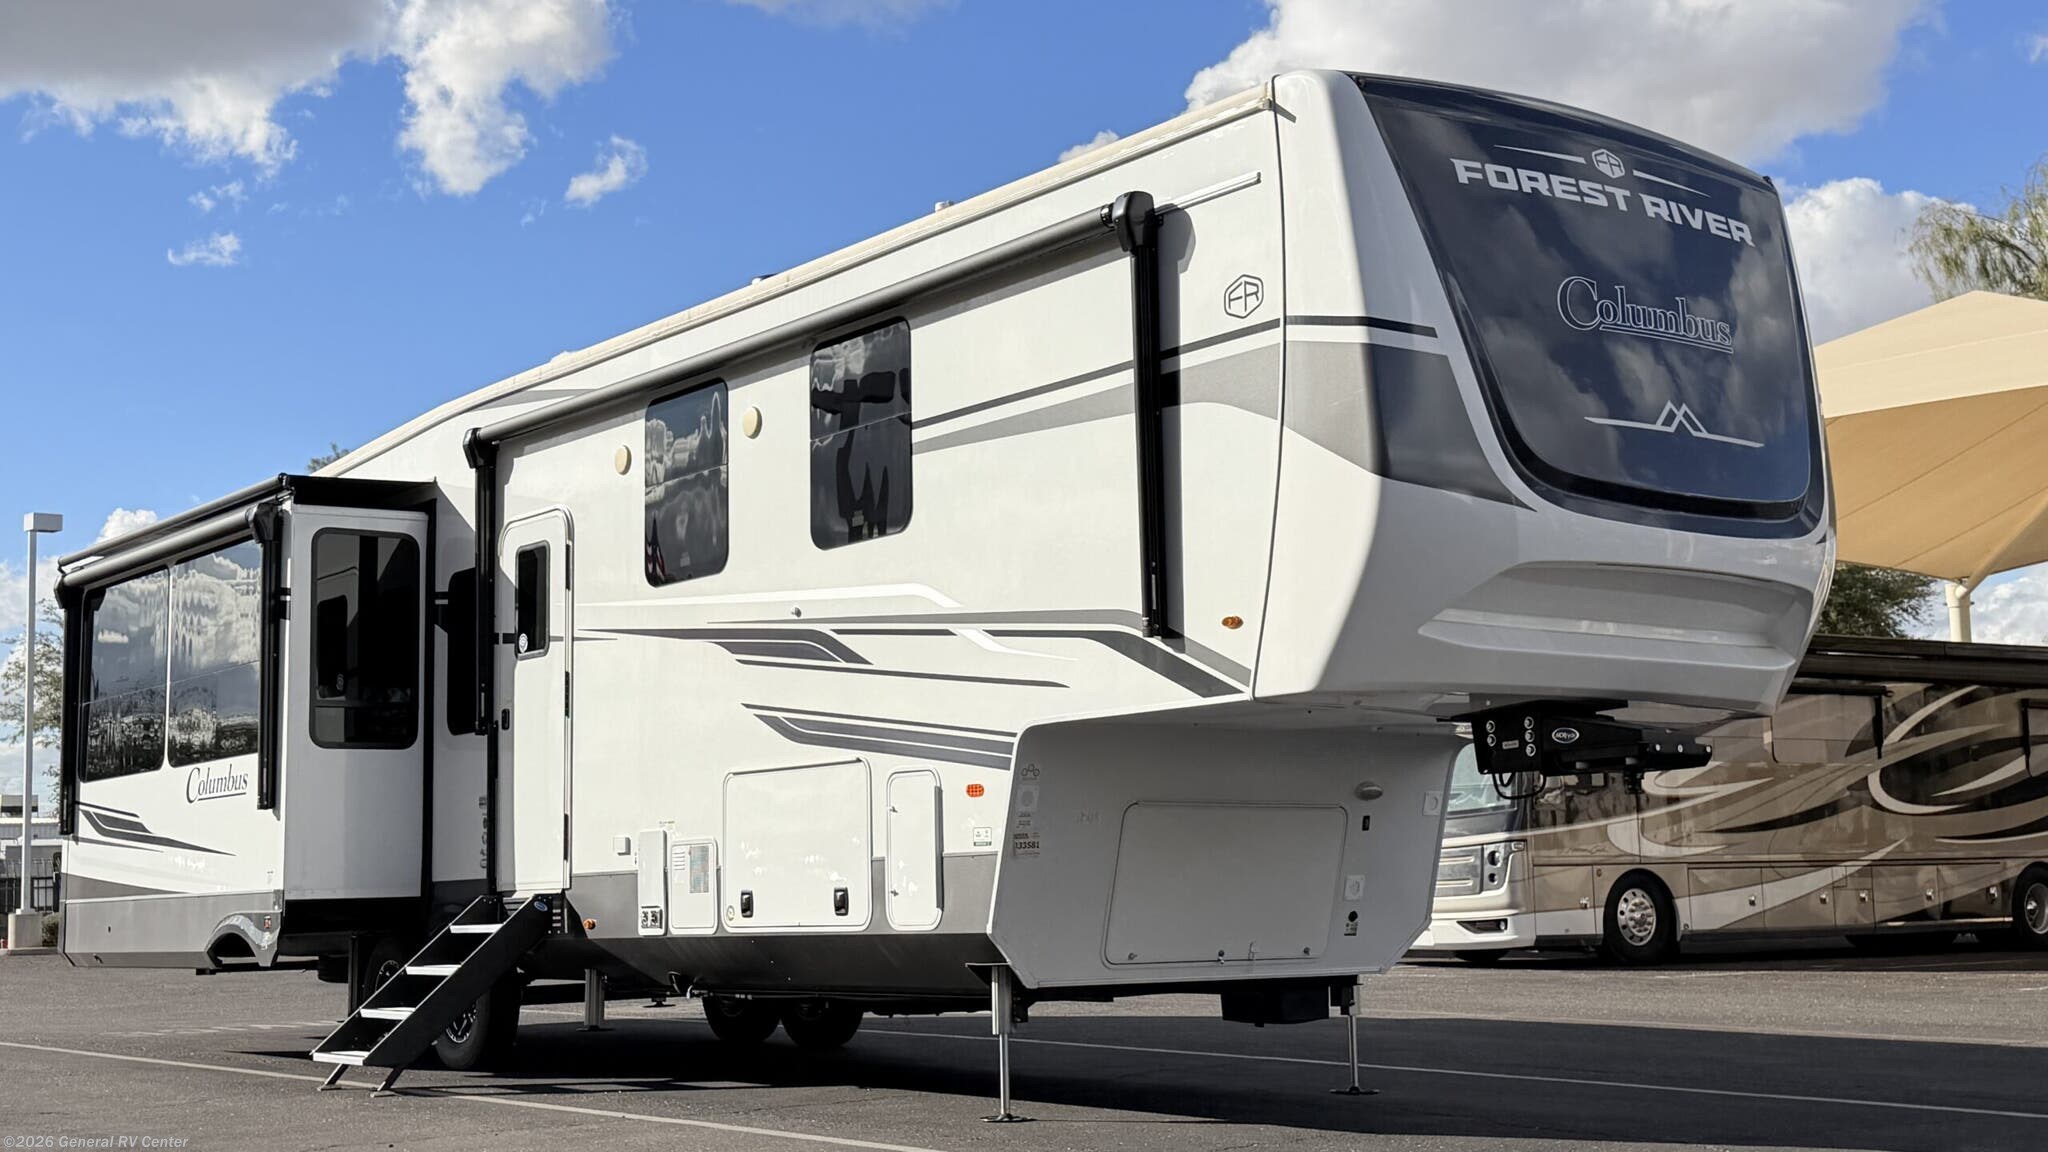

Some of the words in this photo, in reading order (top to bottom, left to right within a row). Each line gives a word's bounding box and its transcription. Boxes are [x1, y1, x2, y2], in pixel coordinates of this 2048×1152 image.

[1450, 158, 1631, 212] FOREST
[1638, 193, 1756, 247] RIVER
[1557, 275, 1733, 348] Columbus
[186, 763, 249, 804] Columbus
